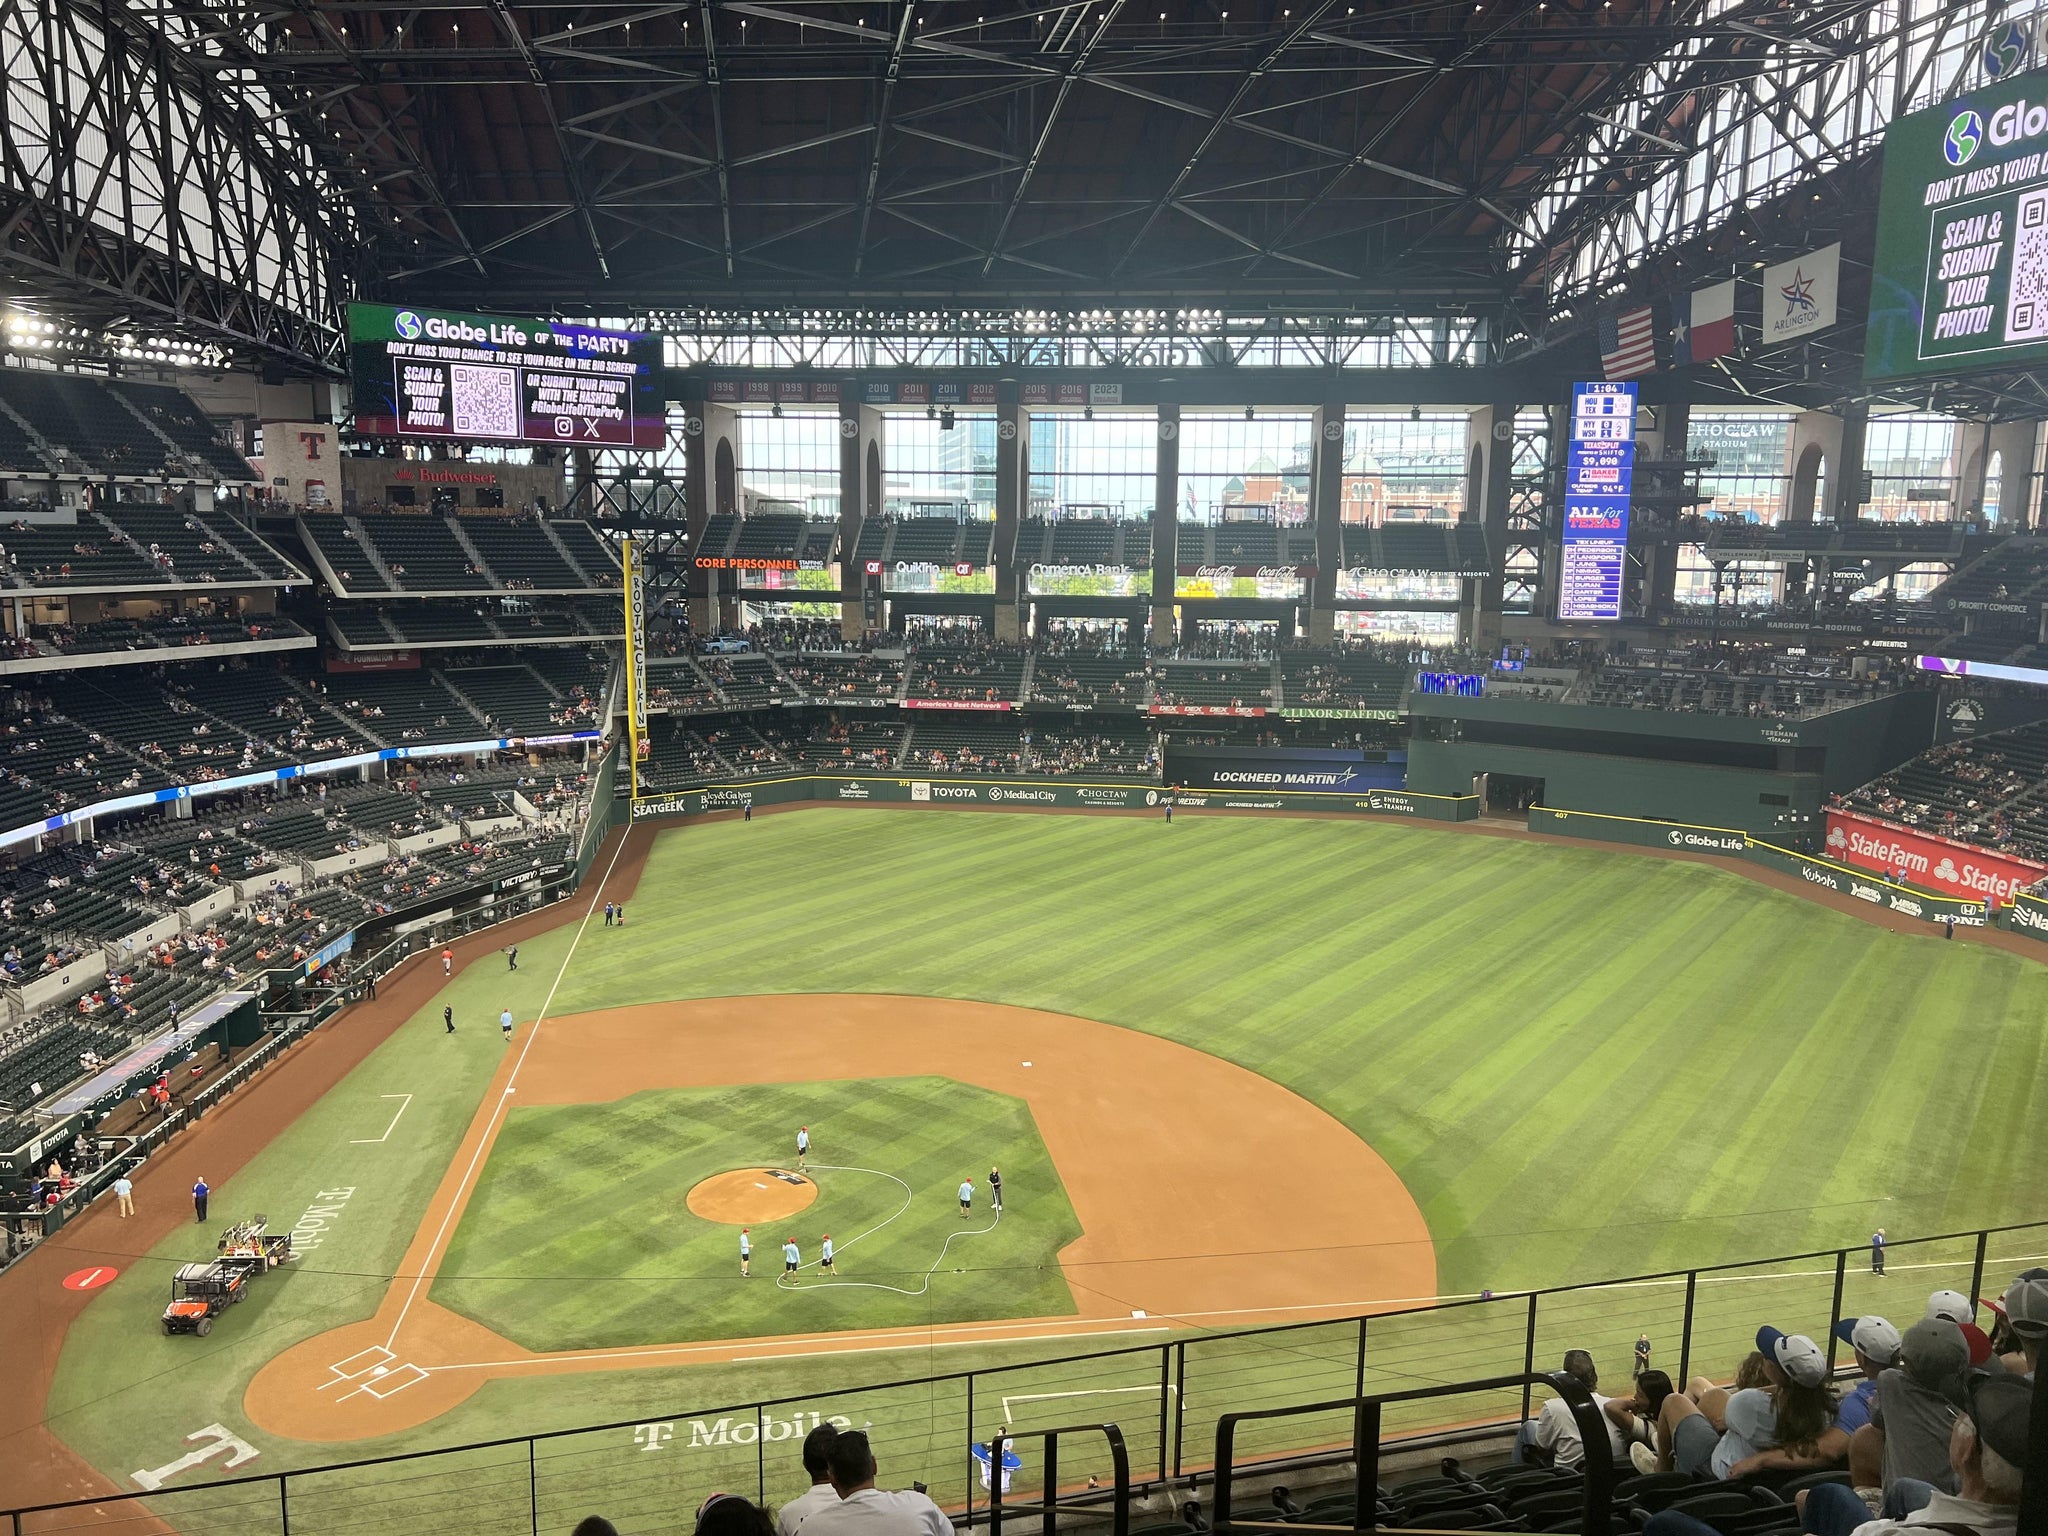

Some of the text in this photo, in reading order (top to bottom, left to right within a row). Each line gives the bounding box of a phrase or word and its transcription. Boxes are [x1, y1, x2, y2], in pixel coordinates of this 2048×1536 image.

[1989, 99, 2048, 146] Glo
[1924, 174, 1965, 206] DON'T
[1964, 164, 2000, 196] MISS
[2002, 153, 2041, 185] YOUR
[1941, 209, 2003, 250] SCAN &
[1937, 240, 2003, 281] SUBMIT
[1945, 274, 1990, 309] YOUR
[1773, 309, 1820, 331] ARLINGTON
[1933, 304, 1994, 341] PHOTO!
[425, 318, 629, 355] Globe Life OF THE PARTY
[386, 341, 637, 374] DON'T MISS YOUR CHANCE TO SEE YOUR FACE ON THE BIG SCREEN!
[403, 365, 443, 382] SCAN &
[403, 380, 445, 397] SUBMIT
[526, 373, 626, 393] OR SUBMIT YOUR PHOTO
[713, 383, 734, 392] 1996
[748, 383, 769, 392] 1998
[781, 383, 802, 392] 1999
[816, 383, 837, 392] 2010
[868, 383, 889, 393] 2010
[904, 384, 924, 393] 2011
[938, 384, 957, 393] 2011
[973, 384, 994, 394] 2012
[1024, 384, 1046, 394] 2015
[1061, 384, 1082, 394] 2016
[1094, 384, 1118, 394] 2023
[1593, 384, 1618, 393] 1:04
[538, 387, 617, 406] WITH THE HASHTAG
[1585, 397, 1598, 405] HOU
[411, 396, 440, 411] YOUR
[530, 400, 624, 420] #GlobeLifeOfTheParty
[1585, 406, 1597, 414] TEX
[407, 410, 445, 427] PHOTO!
[1583, 420, 1596, 428] NYY
[687, 422, 701, 432] 42
[842, 423, 856, 434] 34
[1000, 424, 1014, 436] 26
[1164, 425, 1172, 437] 7
[1325, 425, 1341, 436] 29
[1616, 425, 1622, 433] 2
[1582, 430, 1597, 438] WSH
[300, 432, 325, 460] T
[1703, 440, 1748, 448] STADIUM
[419, 468, 496, 484] Budweiser
[1602, 485, 1624, 493] 94°F
[1568, 506, 1624, 525] ALL for
[1568, 518, 1621, 529] TEXAS
[695, 557, 798, 570] CORE PERSONNEL
[867, 561, 940, 575] QT QuikTrip
[956, 563, 969, 575] QT
[1096, 563, 1130, 576] Bank
[1356, 566, 1430, 578] CHOCTAW
[633, 576, 642, 626] ROOT
[1958, 601, 2028, 614] PRIORITY COMMERCE
[1670, 616, 1748, 628] PRIORITY GOLD
[1767, 621, 1863, 632] HARGROVE ROOFING
[1882, 626, 1949, 635] PLUCKERS
[634, 634, 642, 645] 4
[1871, 640, 1908, 649] AUTHENTICS
[635, 652, 645, 725] CHIKIN
[722, 703, 741, 711] SHIFT
[916, 701, 952, 709] America's
[1159, 705, 1177, 713] DEX
[1184, 705, 1202, 713] DEX
[672, 708, 691, 716] SHIFT
[1291, 708, 1396, 720] LUXOR STAFFING
[1760, 729, 1798, 738] TEREMANA
[1213, 772, 1337, 785] LOCKHEED MARTIN
[932, 787, 977, 798] TOYOTA
[1003, 789, 1057, 802] Medical City
[1082, 789, 1128, 798] CHOCTAW
[1383, 796, 1409, 804] ENERGY
[633, 799, 685, 818] SEATGEEK
[1383, 803, 1414, 812] TRANSFER
[1684, 834, 1744, 851] Globe Life
[501, 871, 536, 889] VICTORY
[1802, 866, 1838, 890] Kubota
[43, 1127, 69, 1150] TOYOTA
